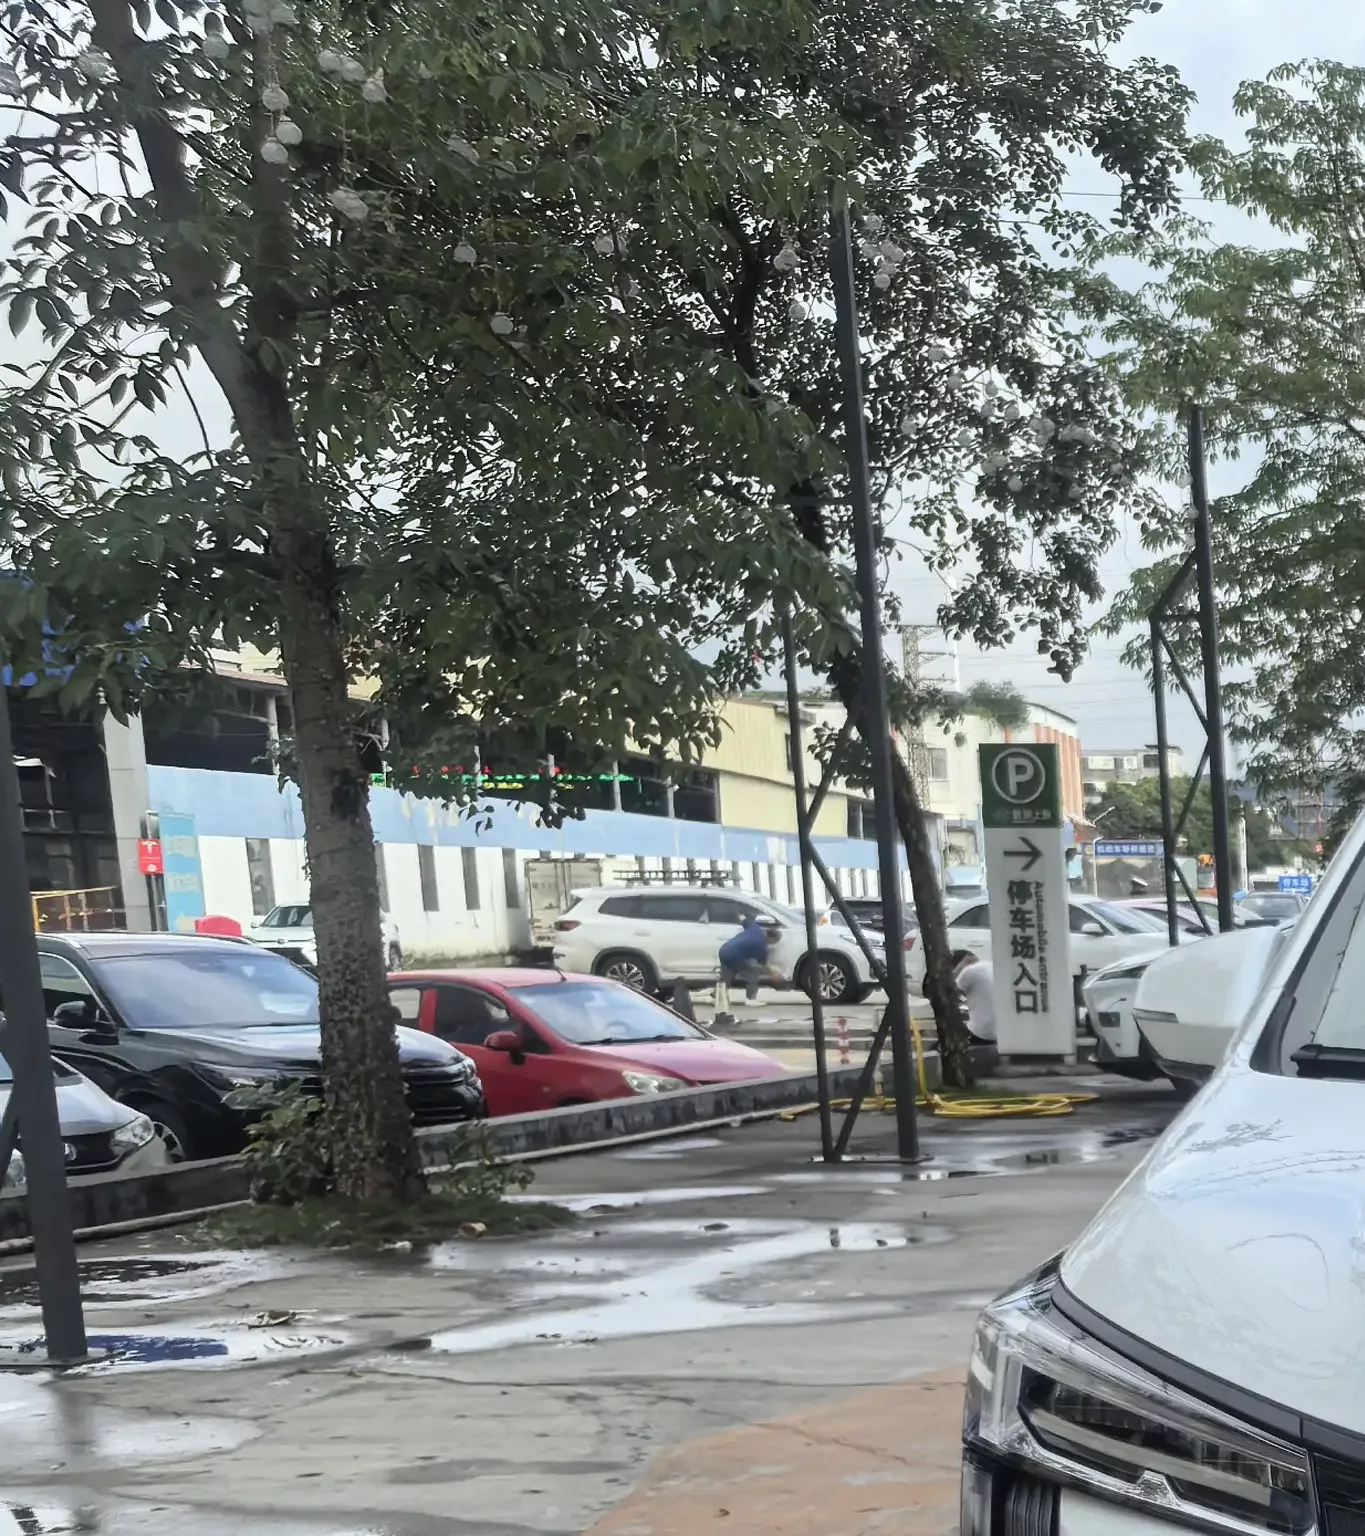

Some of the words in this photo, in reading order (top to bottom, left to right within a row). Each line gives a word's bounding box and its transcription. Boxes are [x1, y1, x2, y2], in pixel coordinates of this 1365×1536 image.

[1008, 757, 1035, 796] P
[1007, 879, 1039, 1015] 停车场入口
